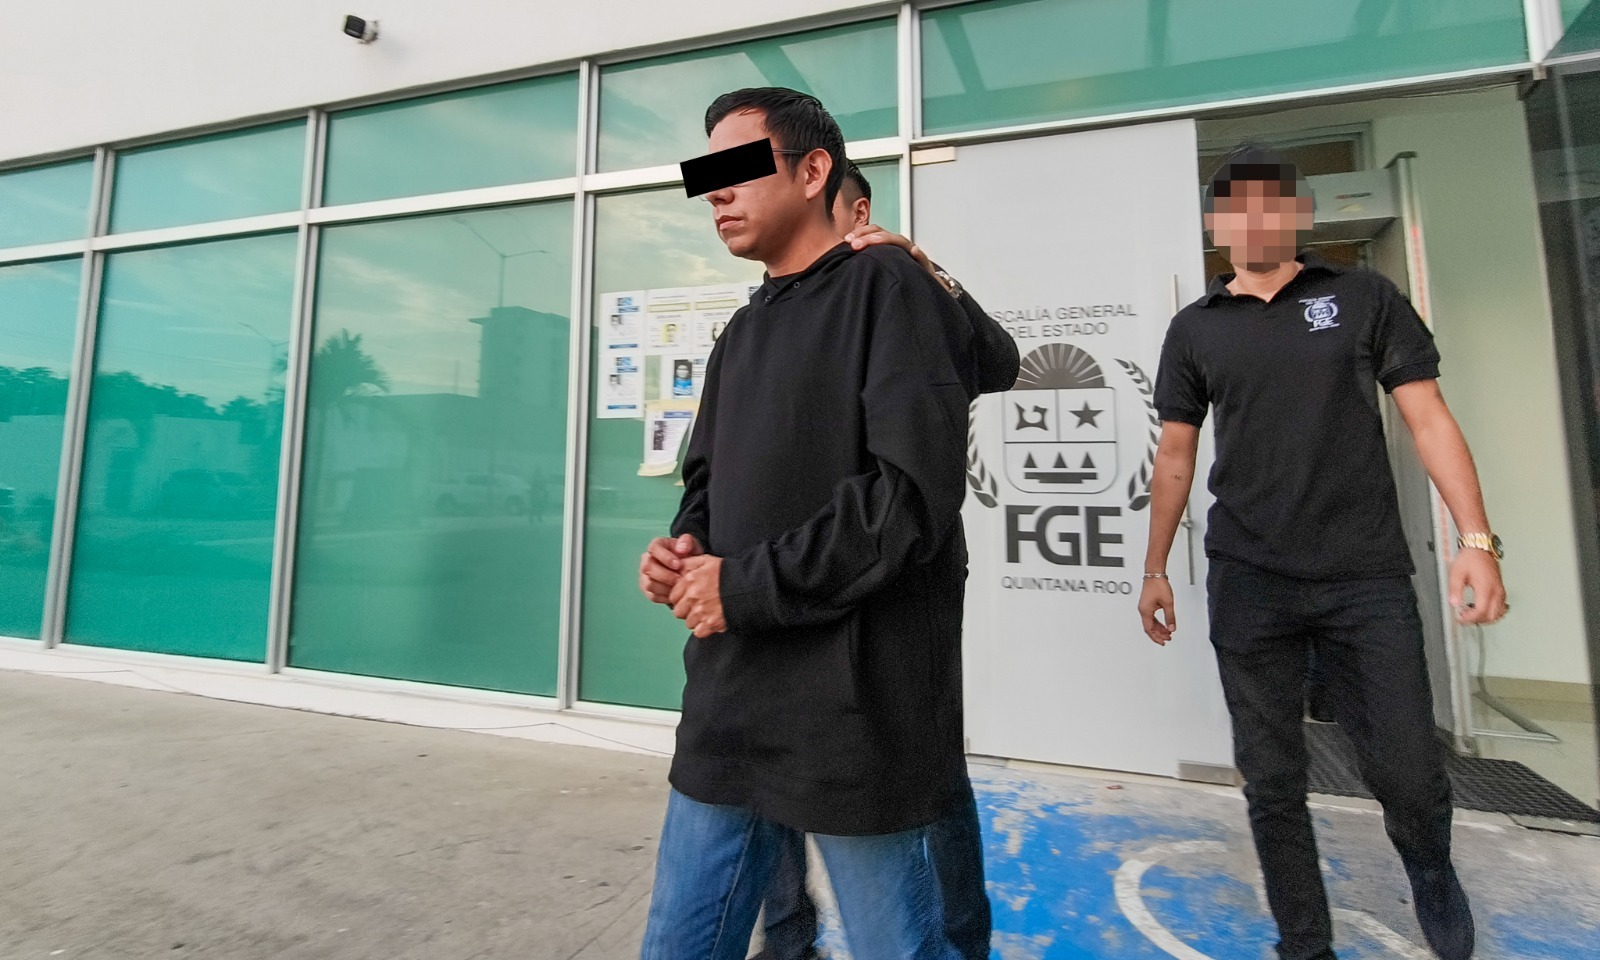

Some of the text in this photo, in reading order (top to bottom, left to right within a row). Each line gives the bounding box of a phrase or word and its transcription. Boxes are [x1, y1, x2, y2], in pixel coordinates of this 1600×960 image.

[1056, 304, 1137, 320] GENERAL
[1042, 322, 1109, 338] ESTADO
[1005, 504, 1125, 568] FGE
[1001, 575, 1133, 595] QUINTANA ROO
